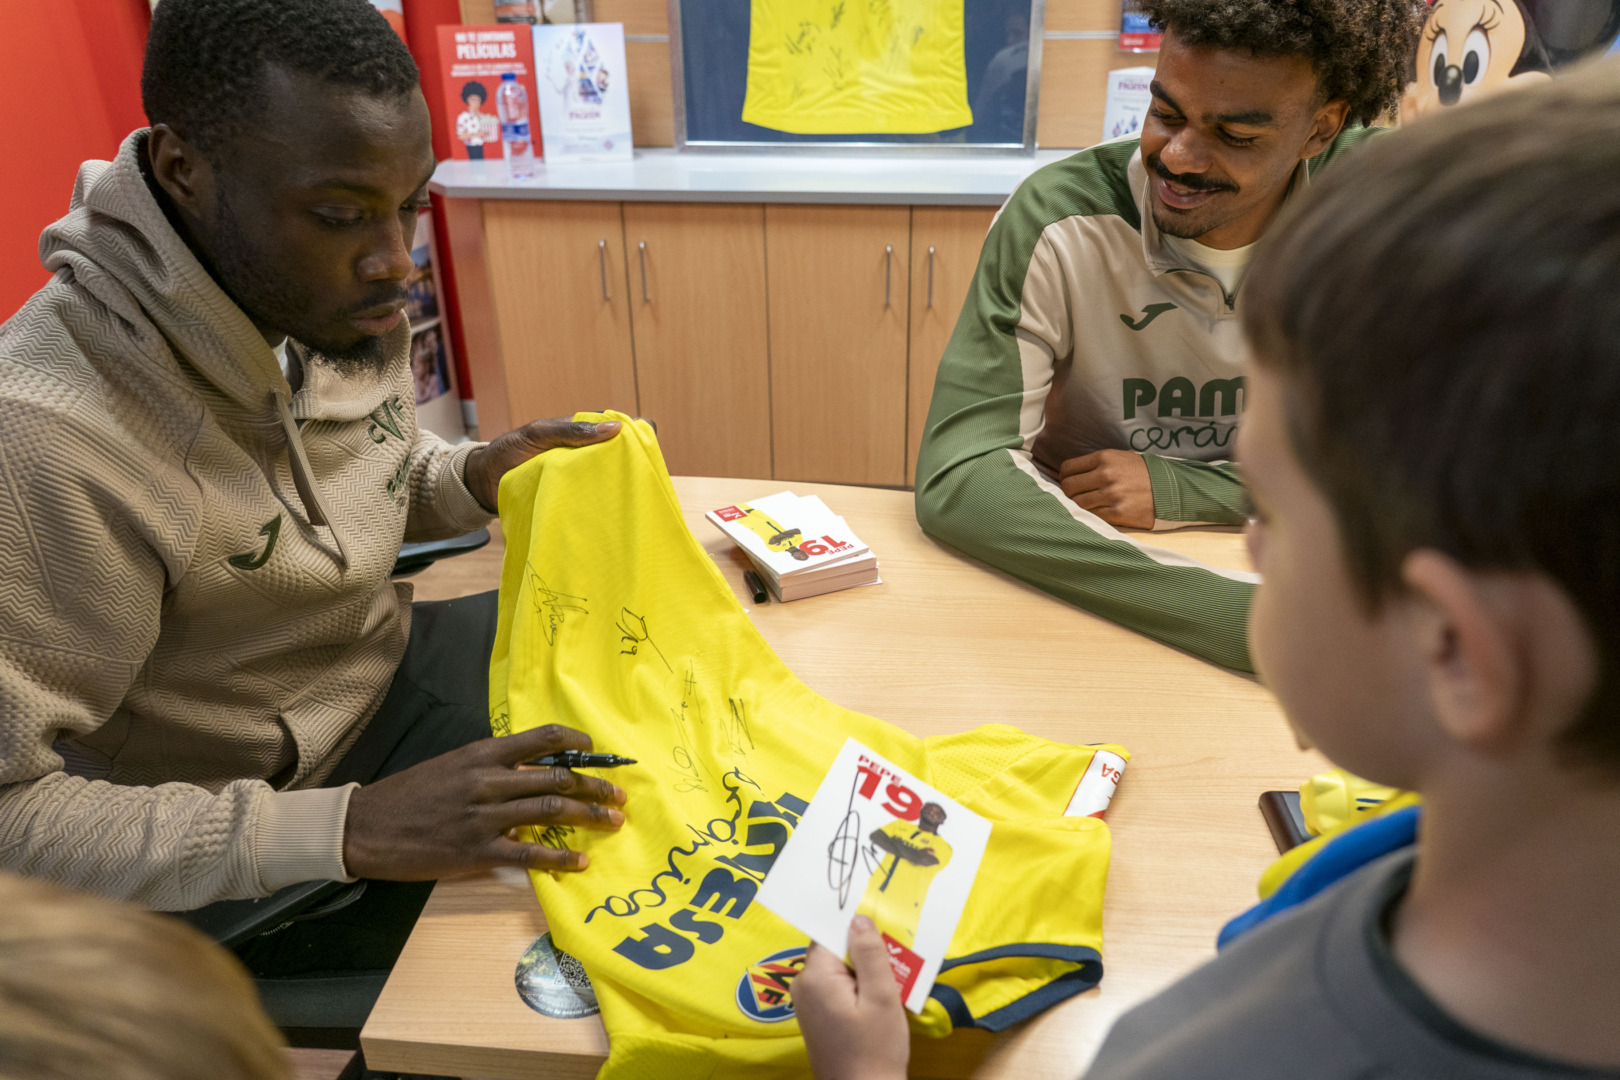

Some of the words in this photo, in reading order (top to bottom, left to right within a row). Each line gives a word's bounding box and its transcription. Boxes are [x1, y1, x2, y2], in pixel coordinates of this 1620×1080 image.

[455, 32, 466, 42] NO
[468, 32, 476, 42] TE
[456, 42, 516, 59] PELÍCULAS
[1129, 421, 1237, 452] cerá
[799, 535, 847, 556] 19
[825, 543, 854, 555] PEPE
[858, 754, 902, 787] PEPE
[857, 765, 923, 822] 19
